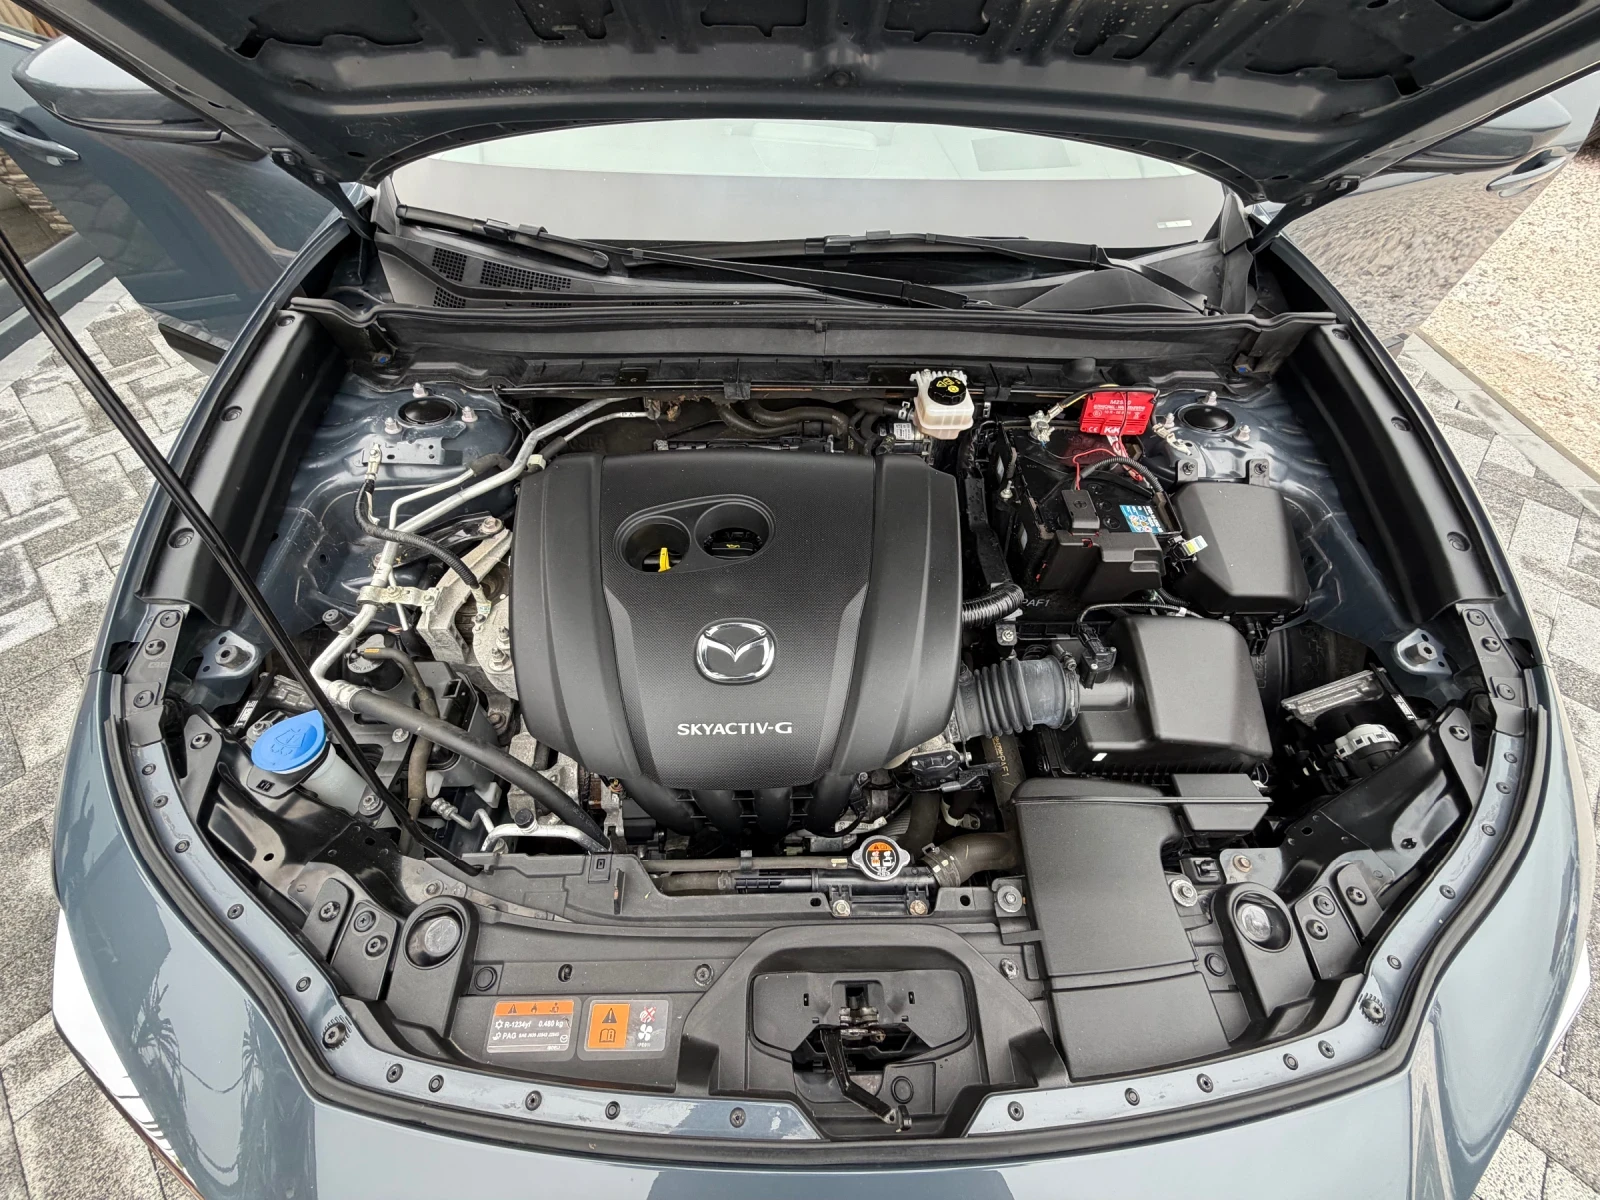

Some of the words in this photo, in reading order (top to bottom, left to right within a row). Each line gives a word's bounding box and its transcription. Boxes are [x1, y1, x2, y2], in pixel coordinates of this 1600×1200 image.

[677, 721, 793, 736] SKYACTIV-G
[504, 1020, 532, 1029] R-1234yf
[555, 1020, 564, 1028] kg
[502, 1032, 517, 1040] PAG
